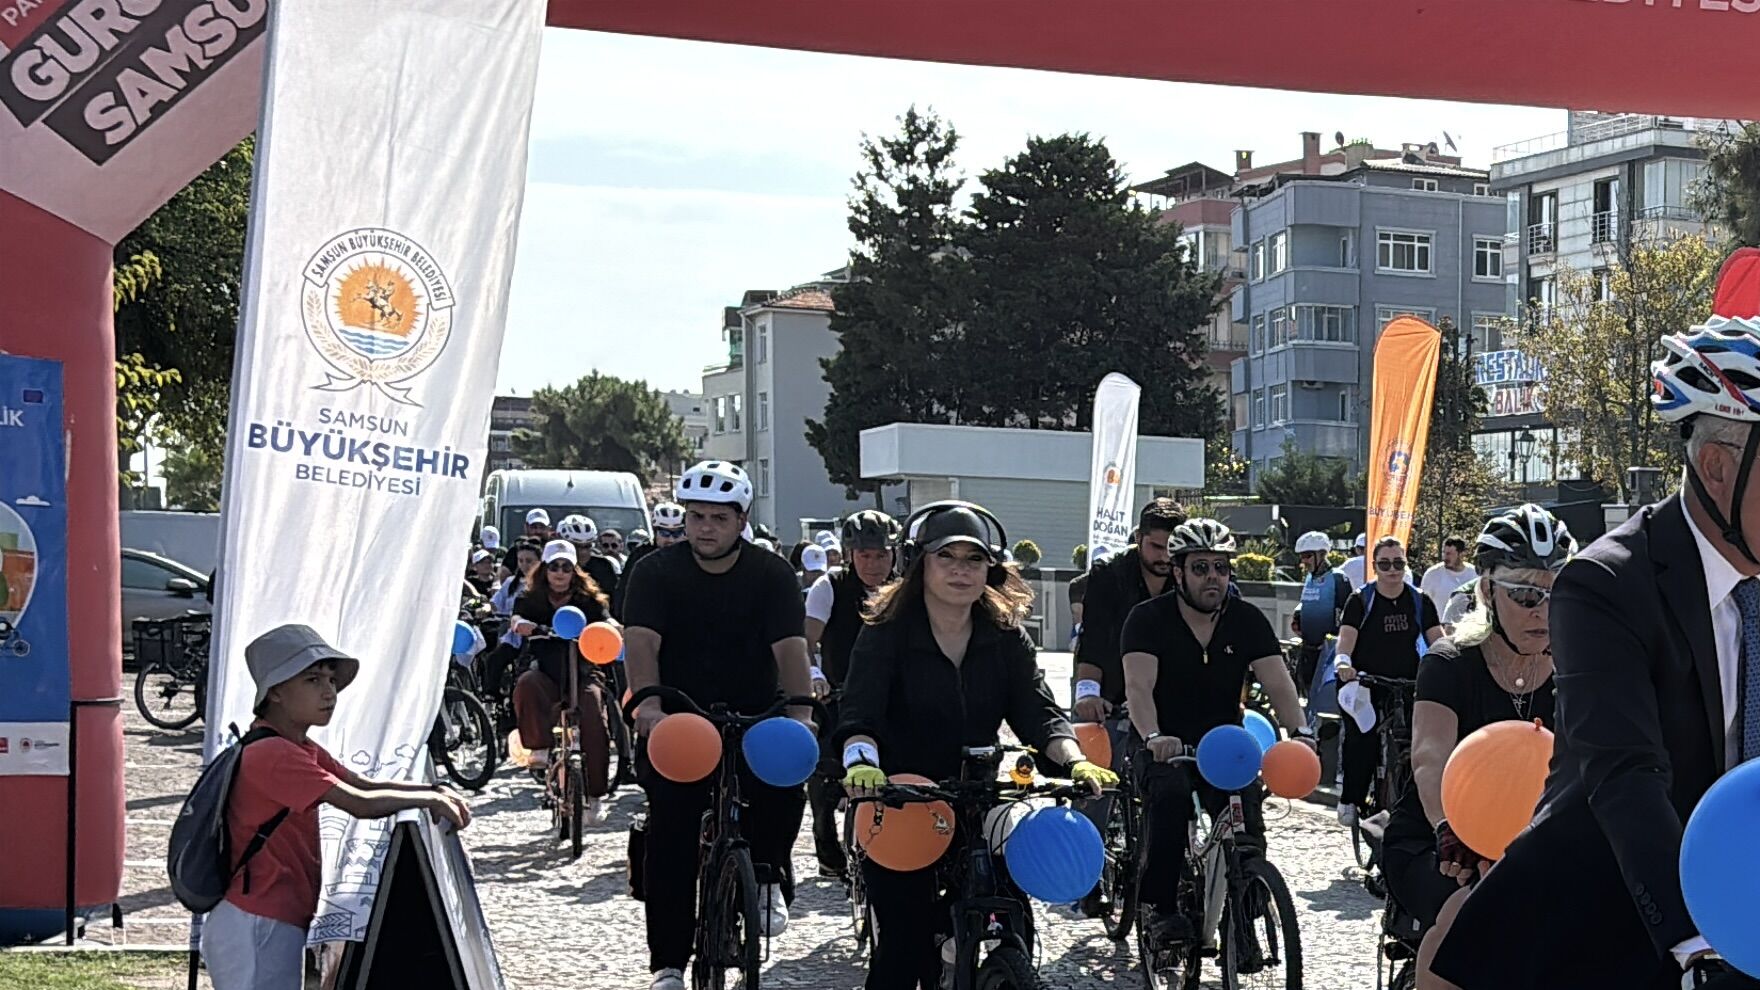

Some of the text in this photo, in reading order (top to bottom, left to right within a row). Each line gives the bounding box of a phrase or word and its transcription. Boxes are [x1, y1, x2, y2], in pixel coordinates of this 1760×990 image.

[11, 0, 162, 101] GUR
[84, 0, 268, 145] SAMSU
[312, 240, 349, 278] SAMSUN
[318, 407, 409, 437] SAMSUN
[248, 419, 470, 480] BÜYÜKŞEHİR
[295, 463, 421, 496] BELEDİYESİ
